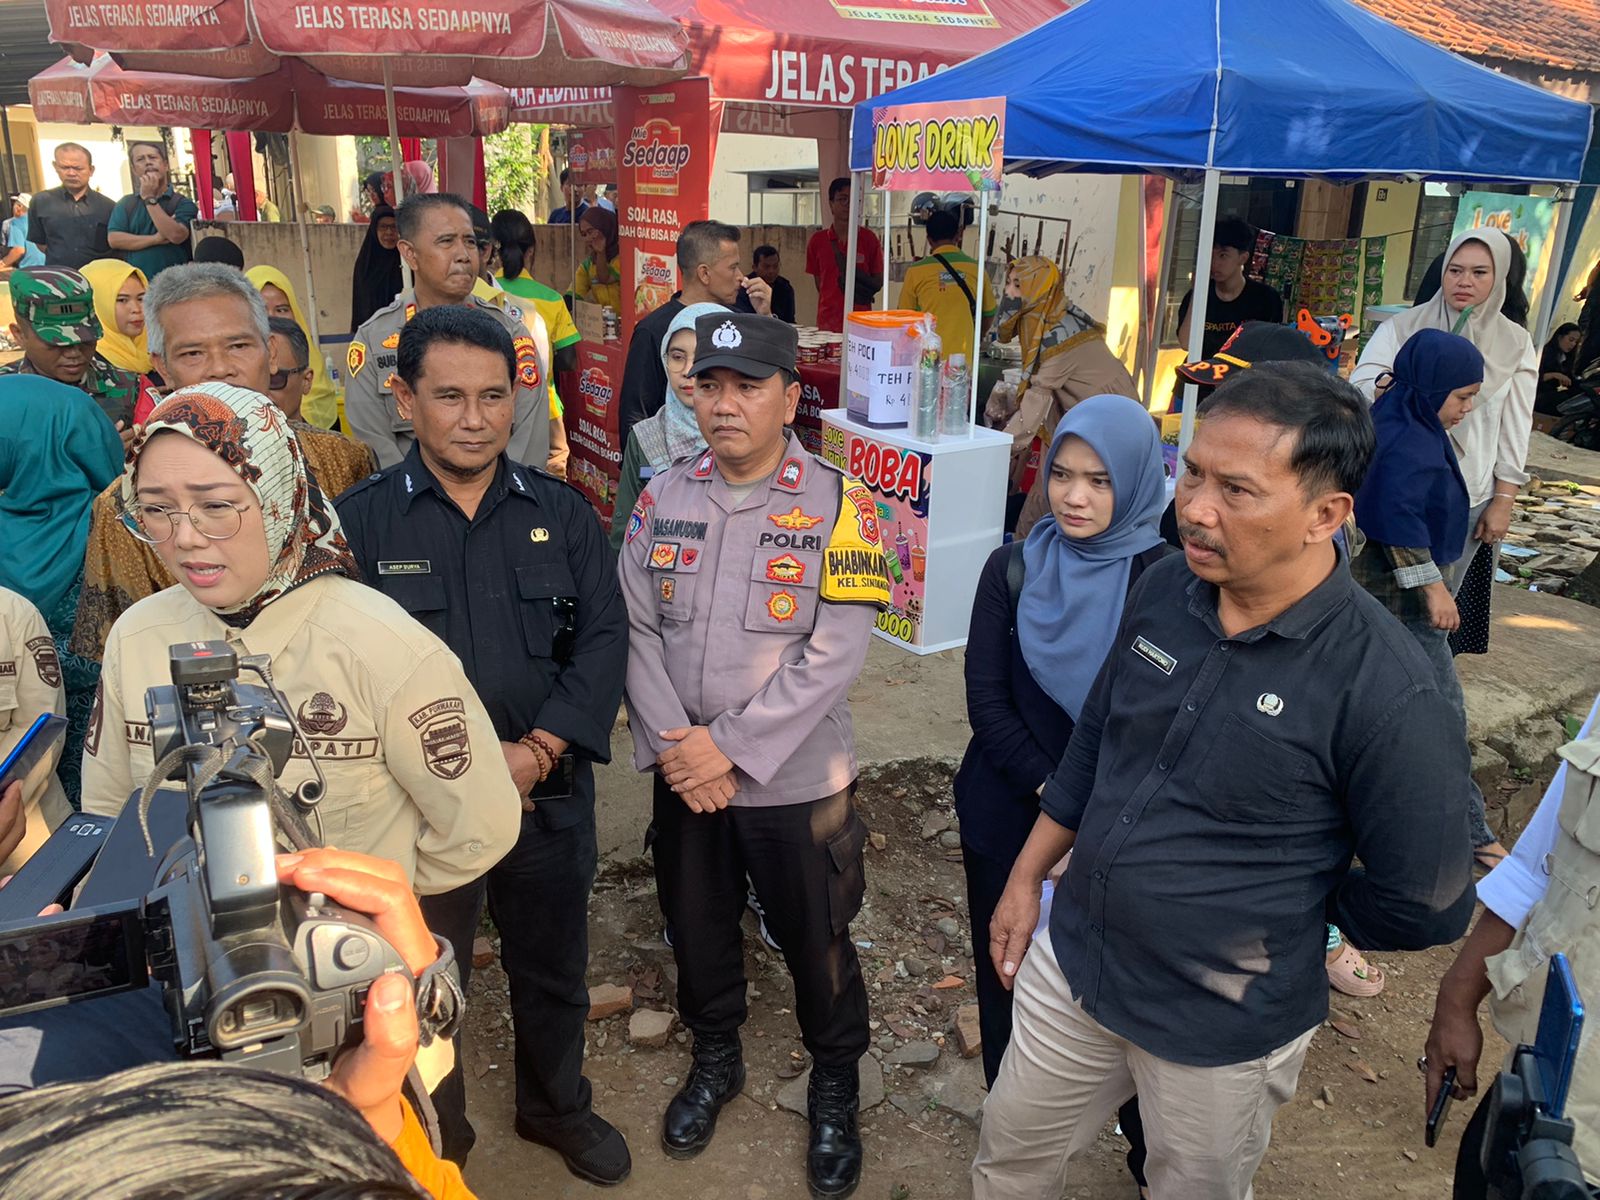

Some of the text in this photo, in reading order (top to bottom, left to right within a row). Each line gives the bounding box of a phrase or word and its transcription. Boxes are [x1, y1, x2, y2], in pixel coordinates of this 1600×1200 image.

[69, 4, 221, 28] JELAS TERASA SEDAAPNYA
[295, 5, 512, 35] JELAS TERASA SEDAAPNYA
[848, 9, 994, 27] JELAS TERASA SEDAPNYA
[766, 49, 951, 104] JELAS TER
[119, 93, 270, 117] JELAS TERASA SEDAAPNYA
[323, 104, 451, 124] JELAS TERAS SEDAAPNYA
[632, 127, 648, 140] Mie
[875, 115, 999, 171] LOVE DRINK
[623, 138, 690, 173] Sedaap
[627, 206, 651, 223] SOAL
[637, 226, 651, 239] GAK
[651, 228, 669, 242] BISA
[641, 264, 671, 279] Sedaap
[377, 354, 397, 369] SUB
[877, 372, 902, 385] TEH
[579, 378, 613, 402] Sedaap
[849, 436, 921, 501] BOBA
[759, 532, 822, 550] POLRI
[295, 741, 362, 757] UPATI
